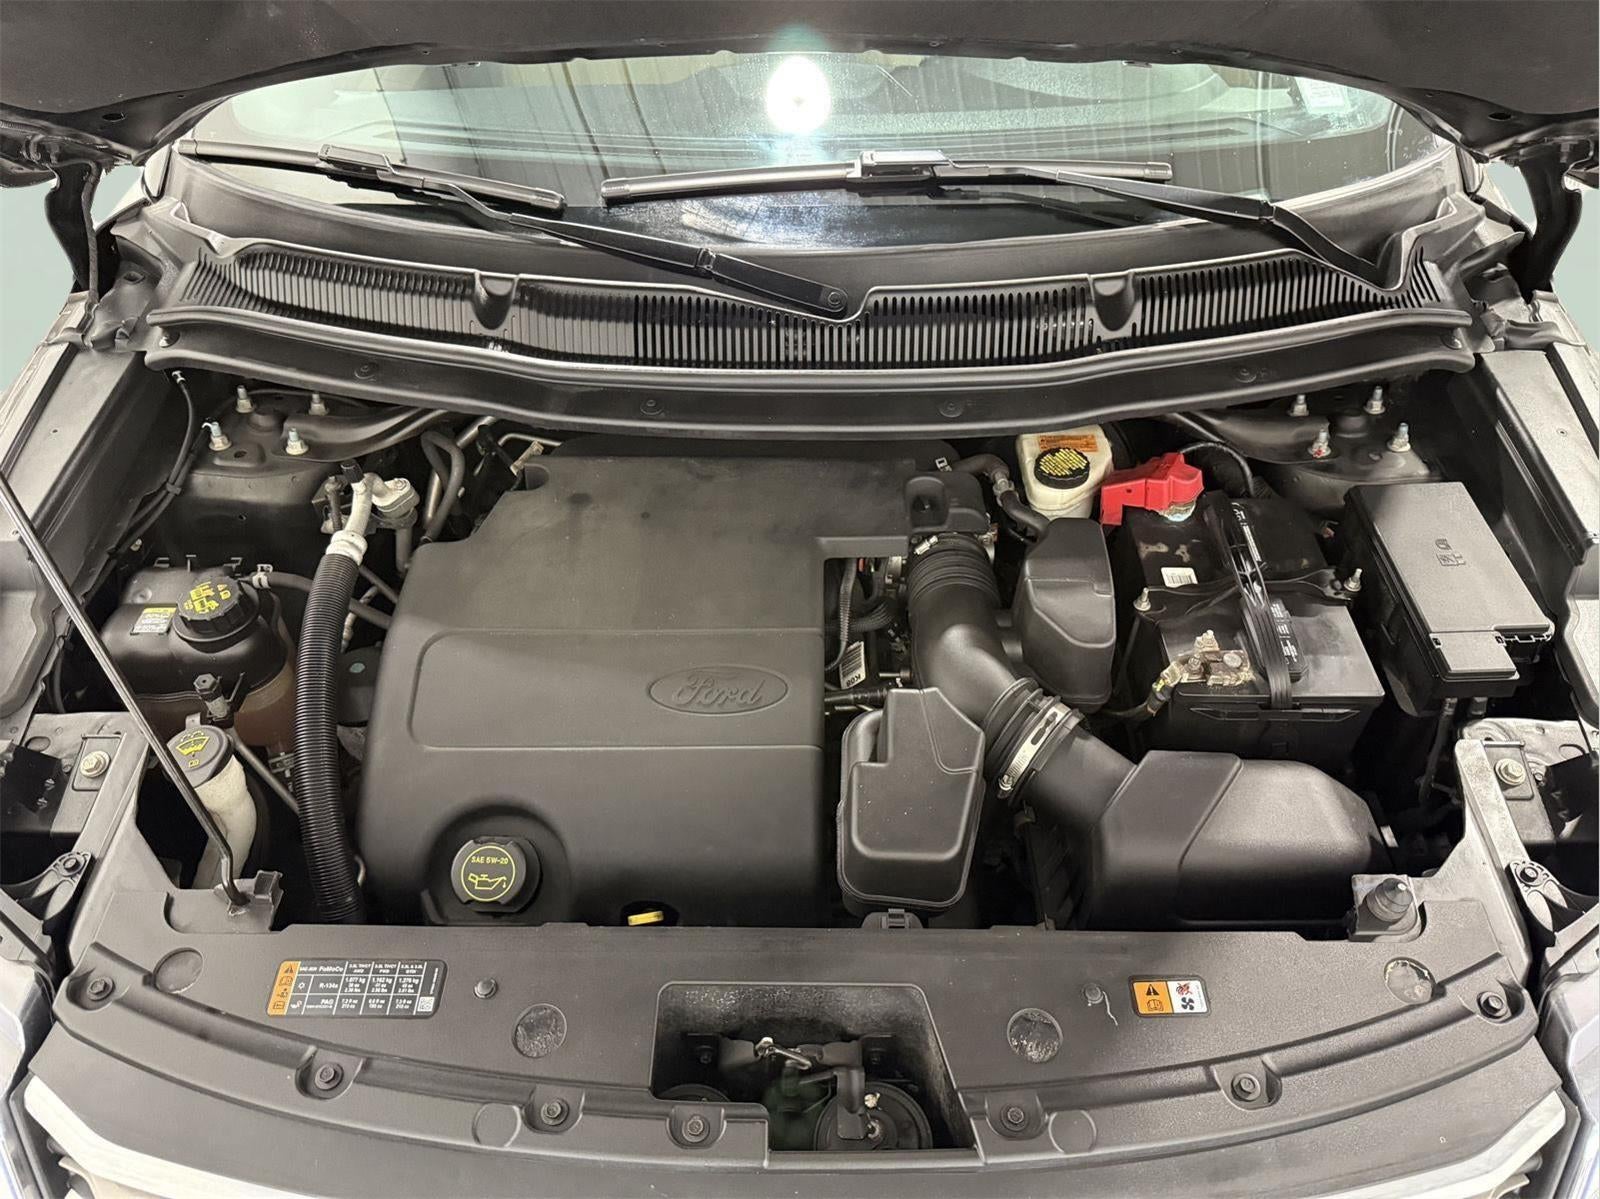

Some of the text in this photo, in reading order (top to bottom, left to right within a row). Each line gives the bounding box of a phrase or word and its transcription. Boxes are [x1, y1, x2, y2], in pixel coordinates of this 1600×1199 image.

[673, 675, 766, 707] Ford
[471, 855, 509, 865] SAE 5W-20
[386, 977, 393, 985] kg
[412, 977, 419, 985] kg
